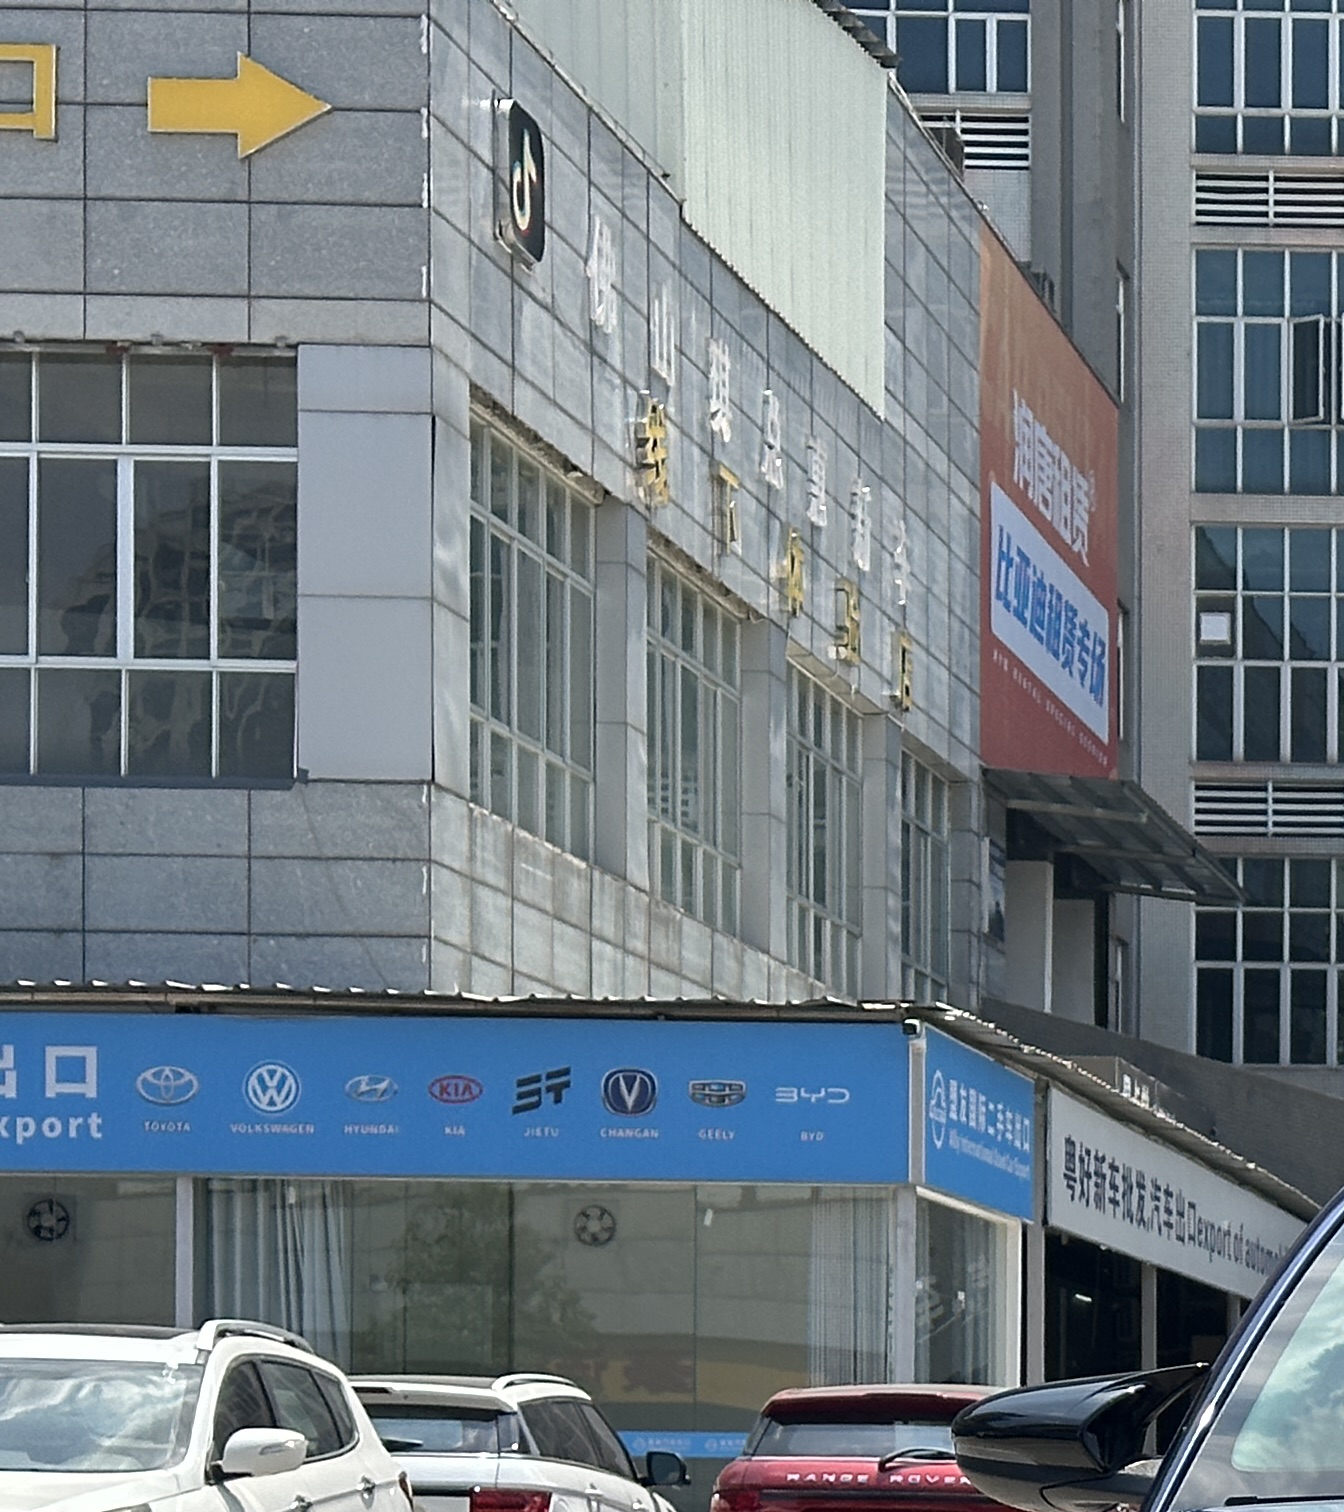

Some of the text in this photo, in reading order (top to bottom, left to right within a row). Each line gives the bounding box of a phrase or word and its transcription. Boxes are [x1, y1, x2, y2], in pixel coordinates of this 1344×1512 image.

[995, 524, 1106, 707] 比亚迪租赁专场
[143, 1120, 191, 1132] TOYOTA
[229, 1122, 315, 1135] VOLKSWAGEN
[343, 1124, 399, 1135] HYUNDAI
[444, 1126, 466, 1136] KIA
[600, 1127, 659, 1139] CHANGAN
[698, 1129, 735, 1140] GEELY
[801, 1130, 825, 1142] BYD
[786, 1473, 972, 1485] RANGE ROVER
